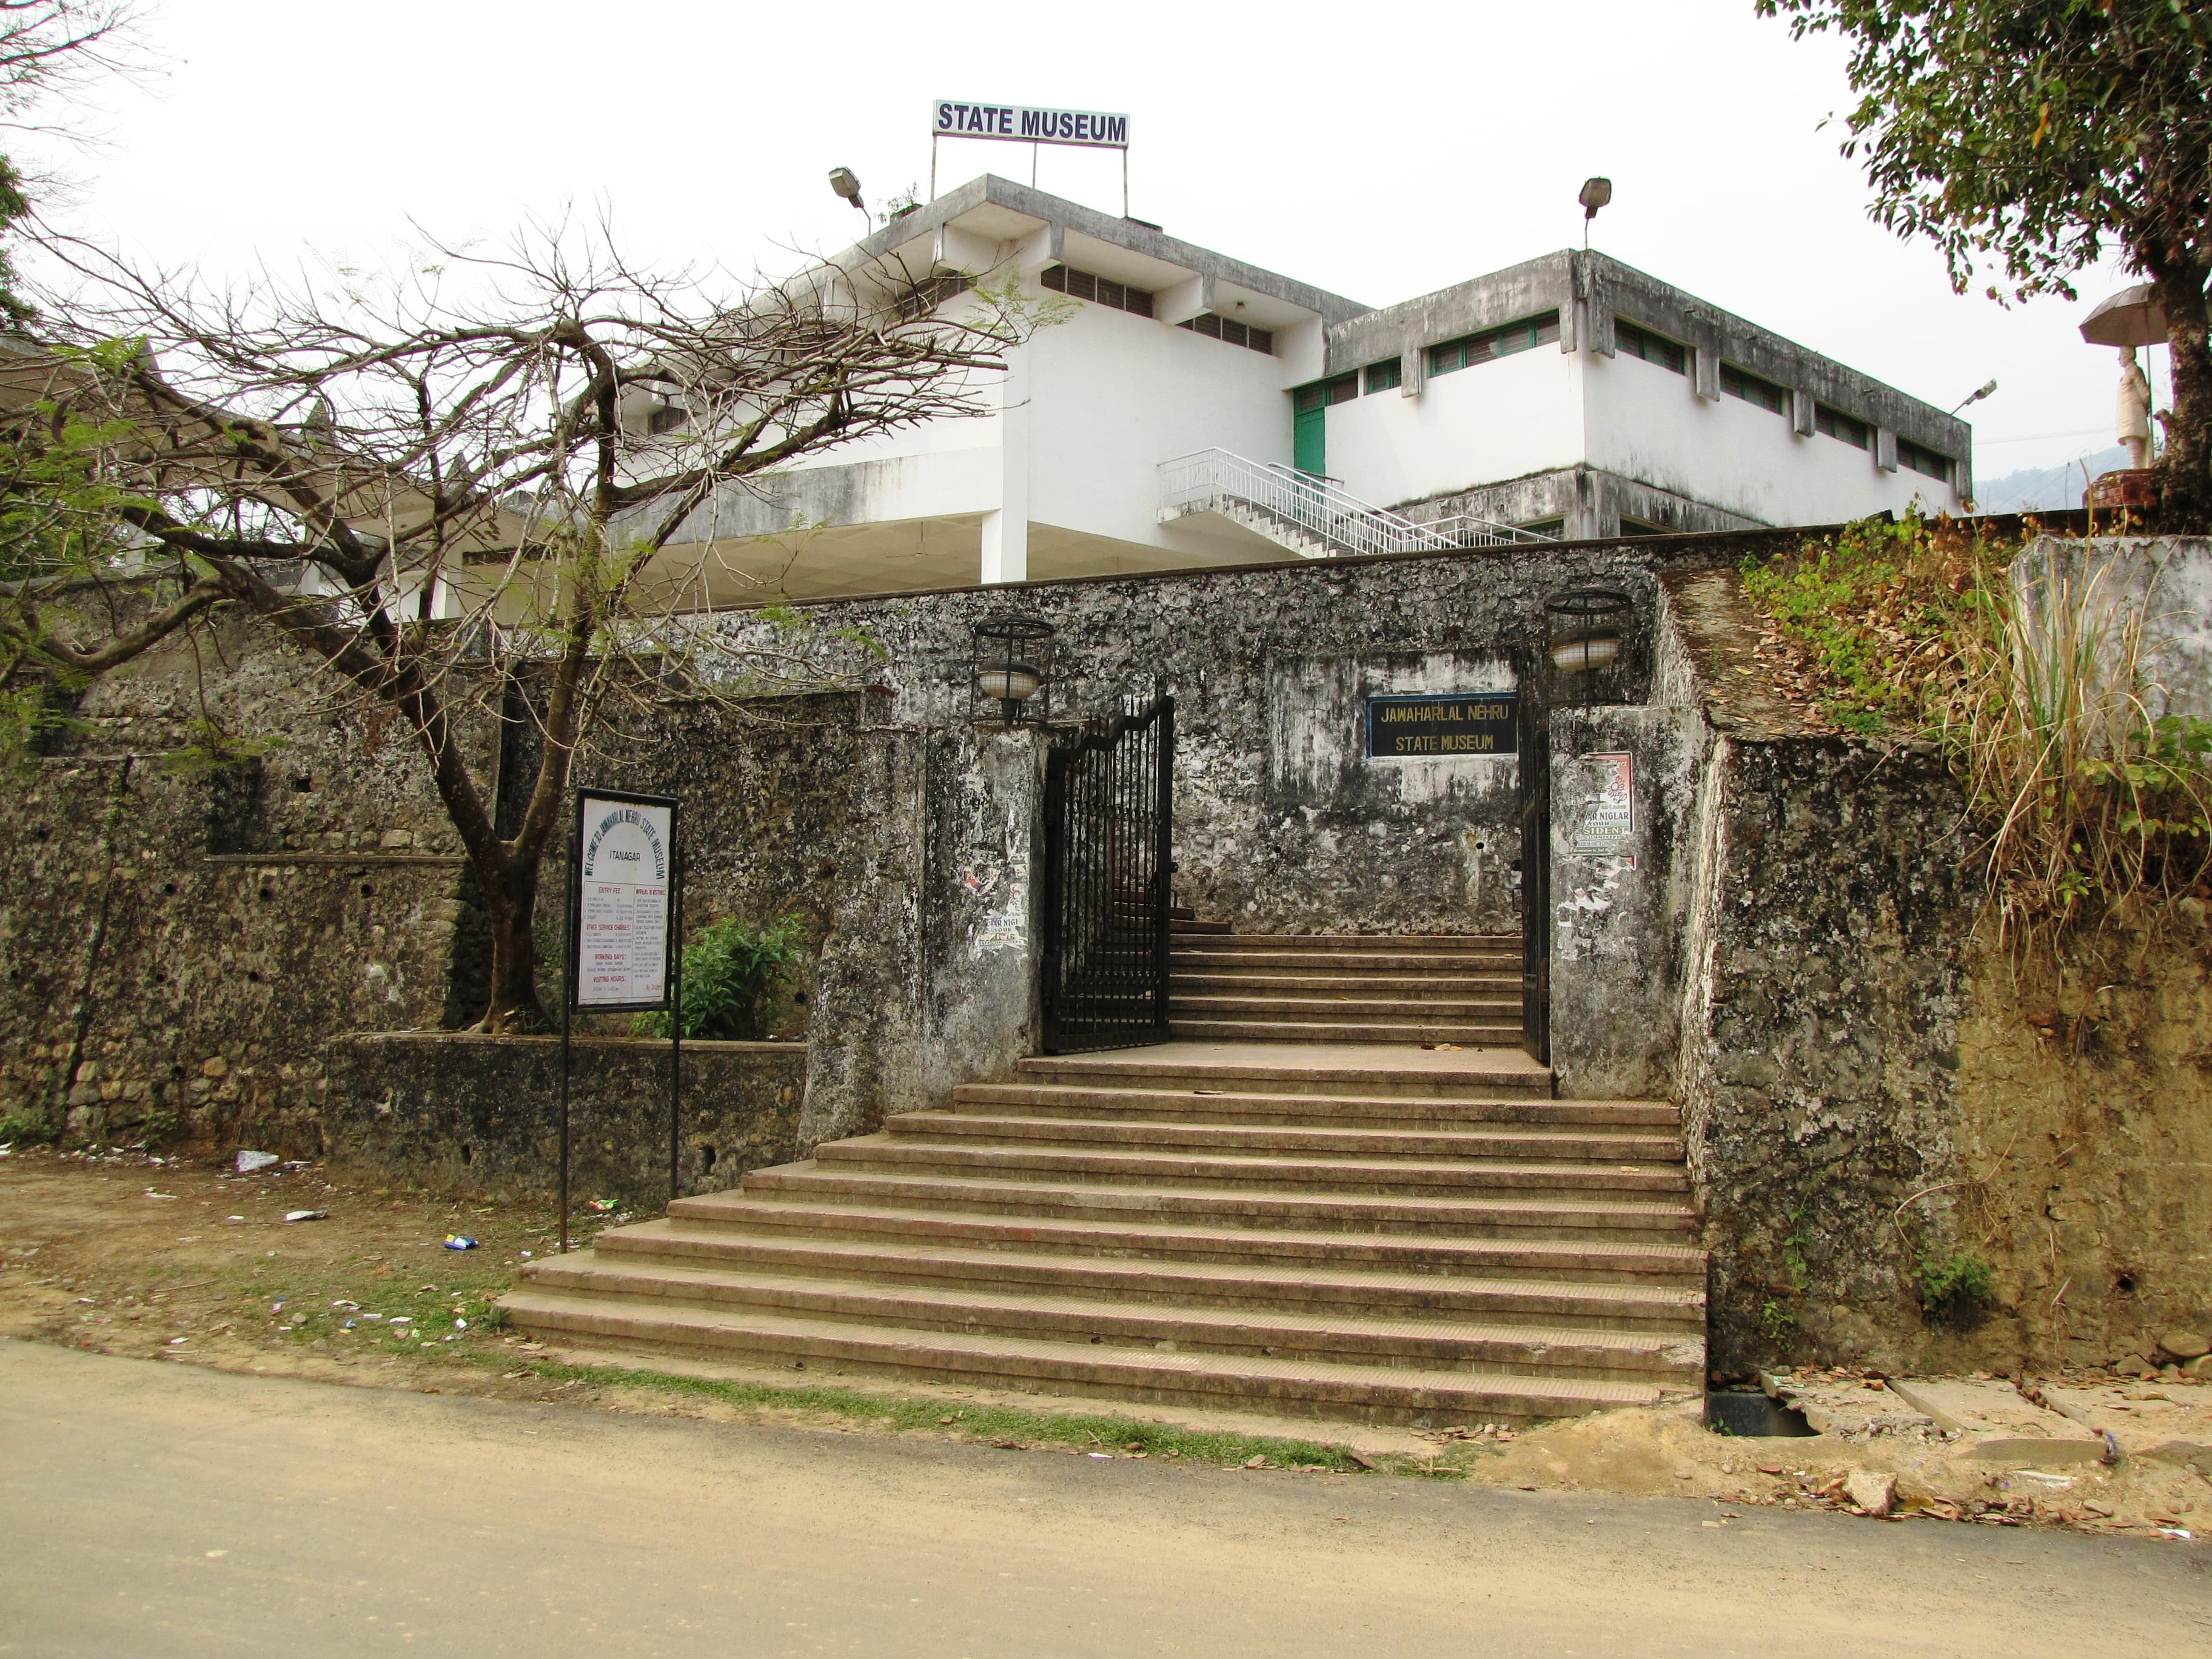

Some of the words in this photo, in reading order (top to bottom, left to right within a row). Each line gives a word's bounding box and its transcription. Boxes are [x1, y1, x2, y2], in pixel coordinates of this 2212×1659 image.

[938, 103, 1013, 134] STATE
[1021, 110, 1127, 142] MUSEUM
[1381, 705, 1463, 723] JAWAHARLAL
[1468, 705, 1509, 720] NEHRU
[1396, 736, 1437, 751] STATE
[1441, 735, 1494, 751] MUSEUM
[594, 830, 602, 843] TO
[640, 817, 656, 841] STATE
[651, 837, 665, 880] MUSEUM
[609, 850, 641, 862] ITANAGAR
